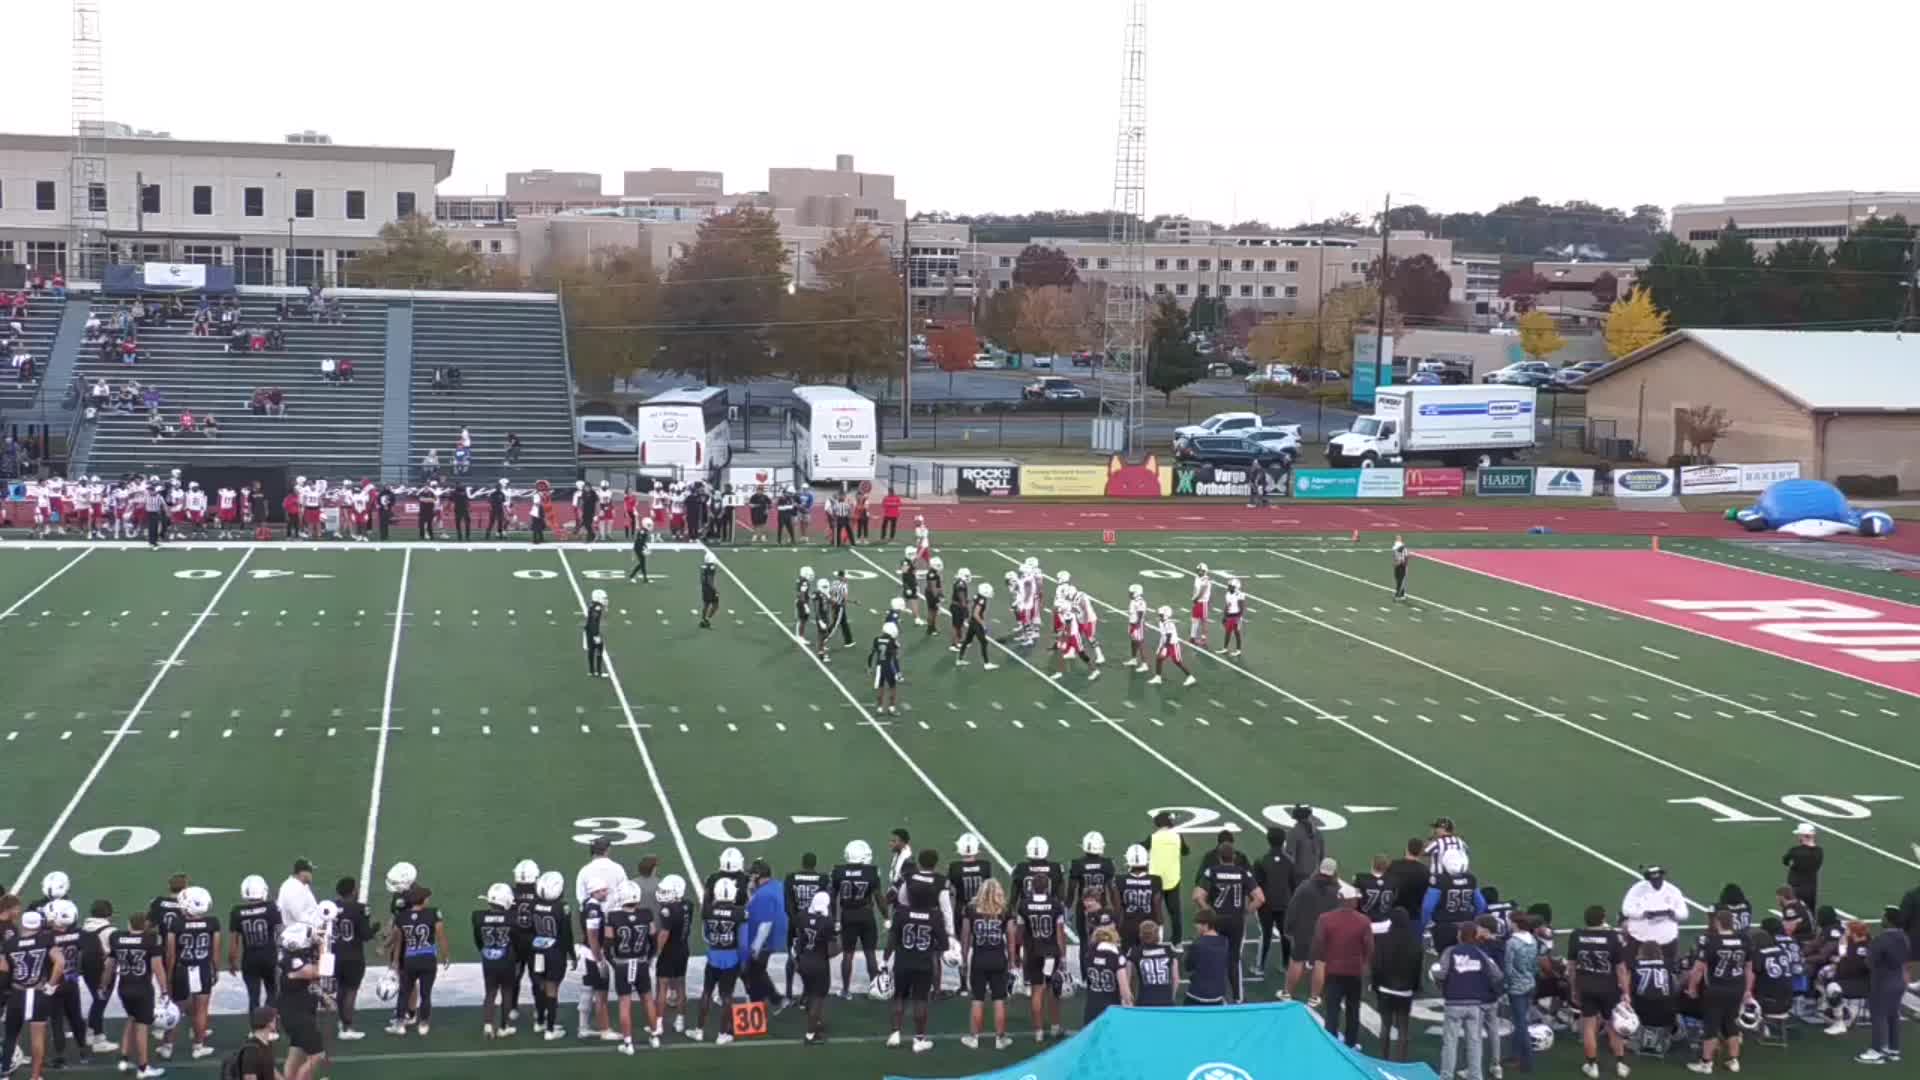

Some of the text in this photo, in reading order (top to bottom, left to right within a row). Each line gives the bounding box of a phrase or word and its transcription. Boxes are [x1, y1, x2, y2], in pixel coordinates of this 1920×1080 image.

[975, 479, 1012, 492] ROLL
[1214, 469, 1246, 483] Vargo
[1483, 474, 1528, 486] HARDY
[1667, 794, 1872, 821] 10
[571, 816, 778, 845] 30
[1213, 882, 1242, 908] 71
[616, 924, 651, 954] 27
[902, 922, 932, 951] 65
[1029, 914, 1054, 938] 10
[1635, 966, 1670, 996] 74
[735, 1006, 763, 1032] 30
